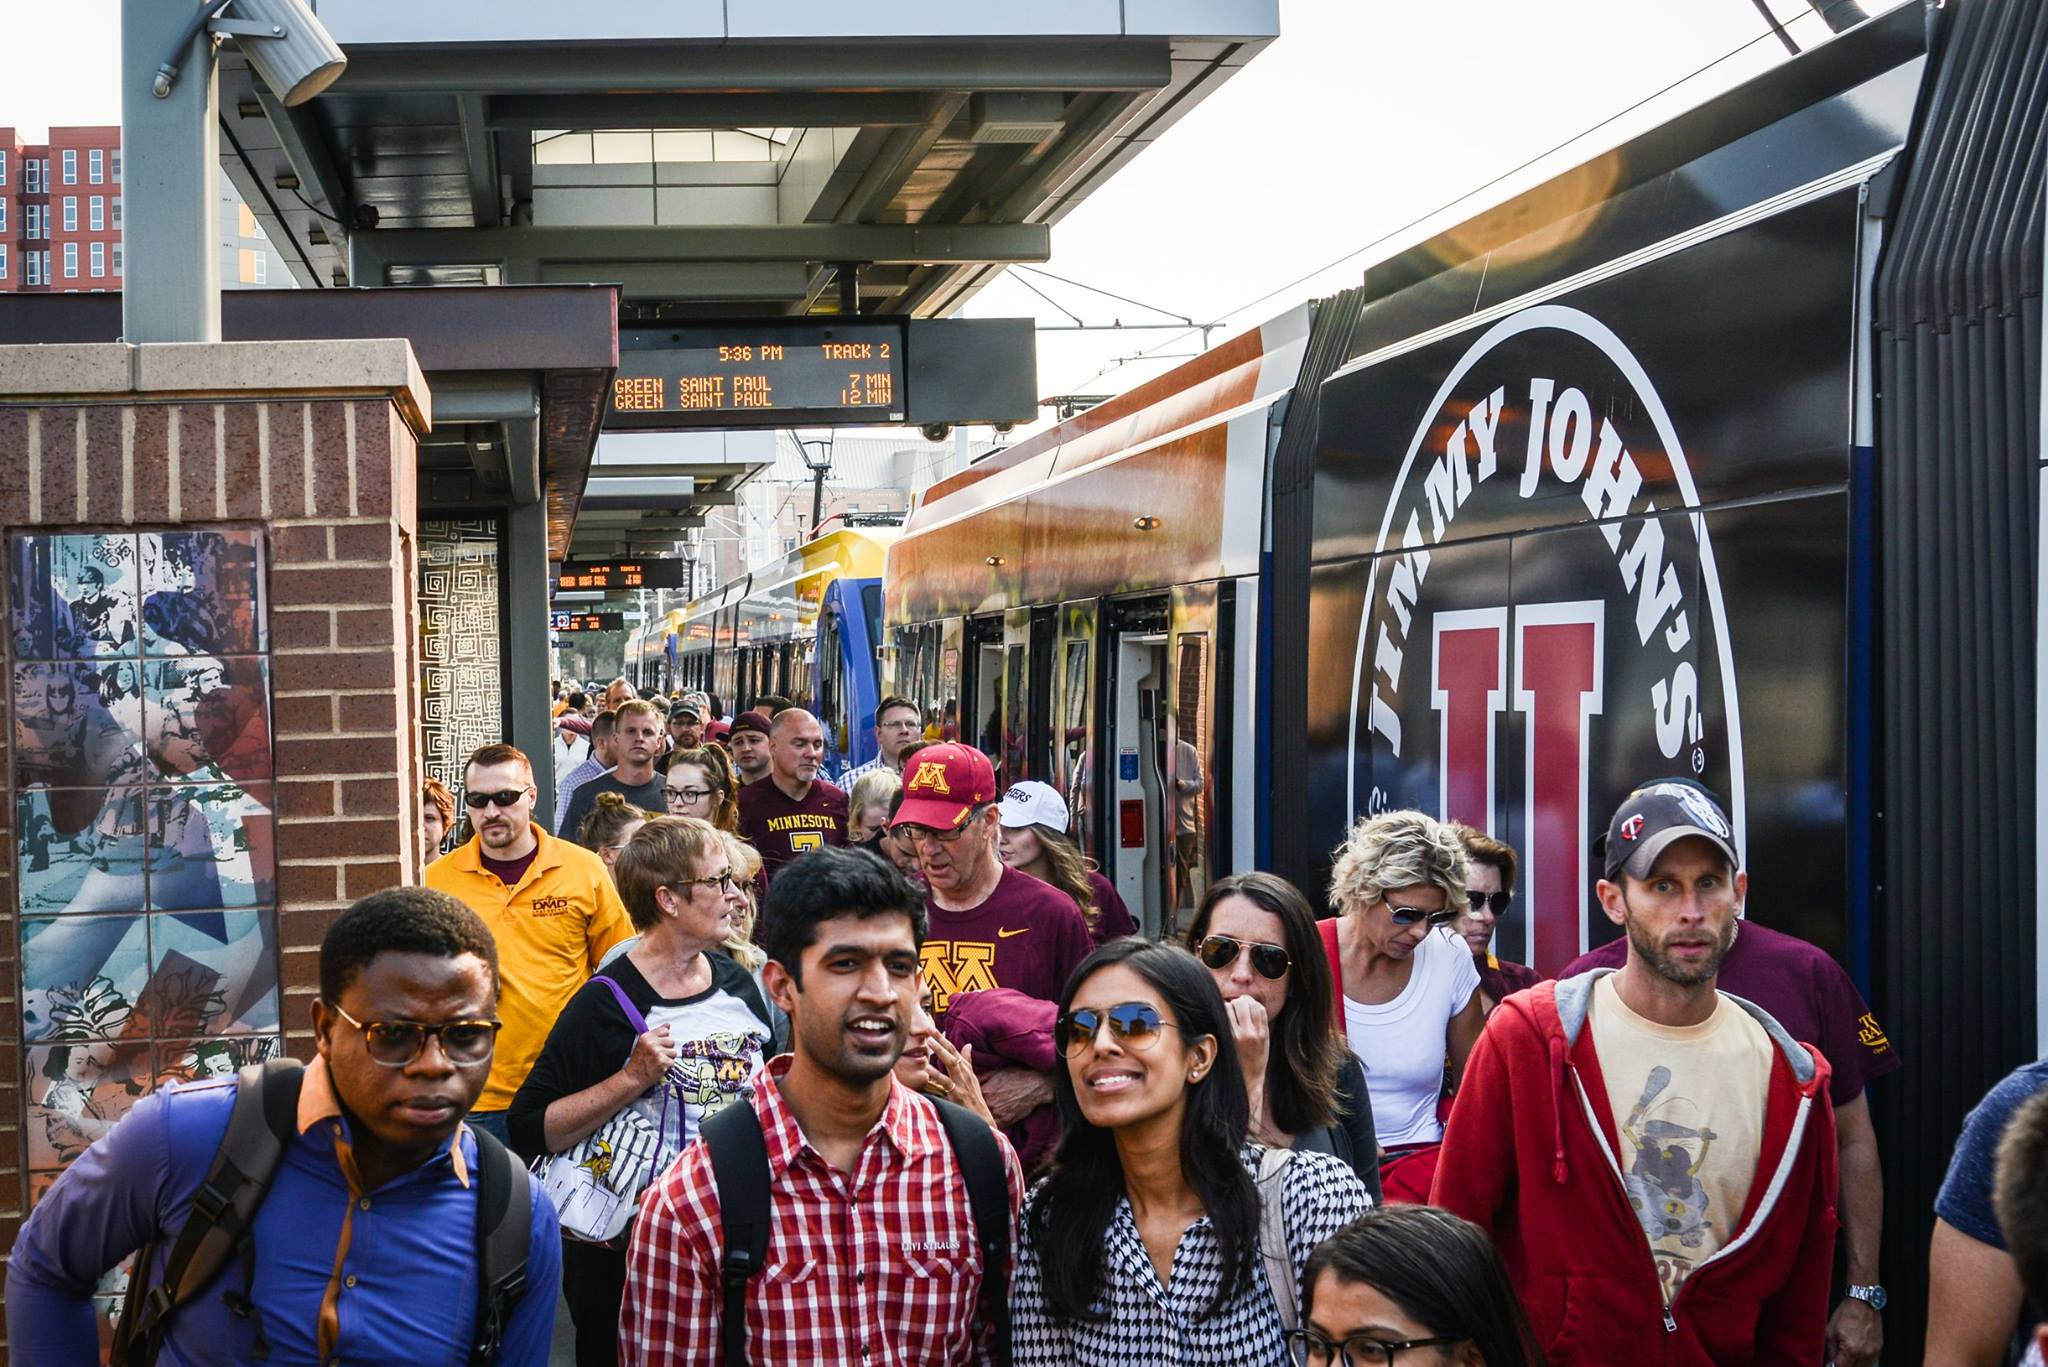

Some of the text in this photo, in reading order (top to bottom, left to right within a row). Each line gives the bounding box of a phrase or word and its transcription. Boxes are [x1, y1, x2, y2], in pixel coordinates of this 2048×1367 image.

[719, 345, 784, 362] 5:36 PM
[822, 343, 891, 360] TRACK 2
[614, 373, 892, 394] GREEN SAINT PAUL 7 MIN
[614, 389, 892, 410] GREEN SAINT PAUL 12 MIN
[1368, 377, 1704, 760] JIMMY JOHN'S
[908, 762, 950, 795] M
[767, 814, 837, 832] MINNESOTA
